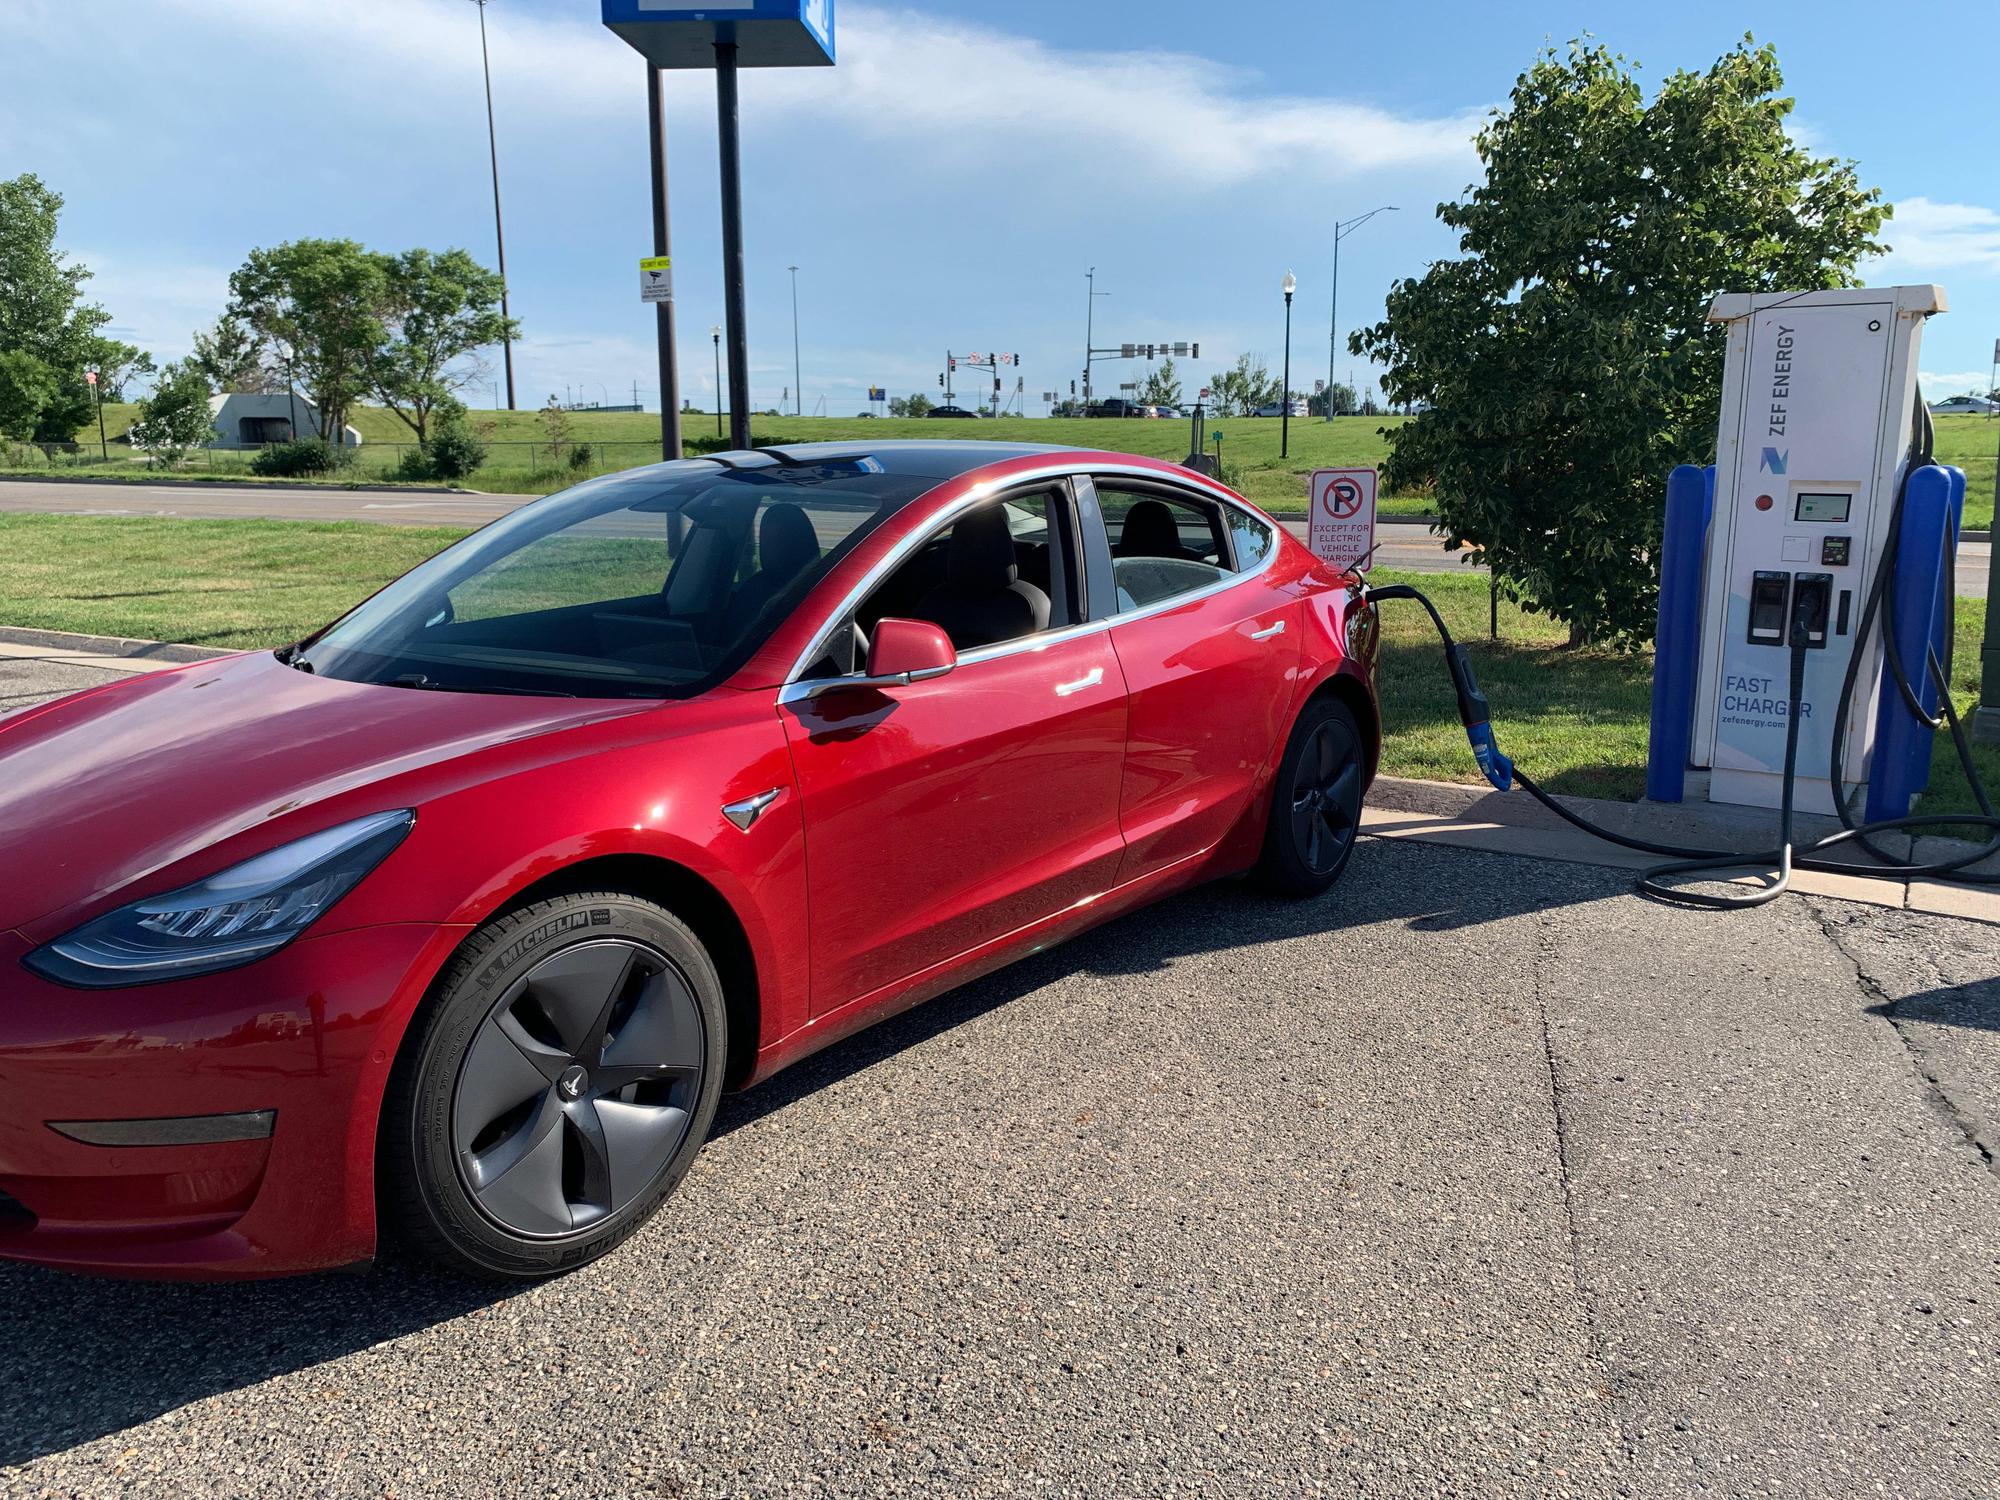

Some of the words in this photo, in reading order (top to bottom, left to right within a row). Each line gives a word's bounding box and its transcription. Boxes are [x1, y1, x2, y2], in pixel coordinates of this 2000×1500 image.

[1772, 326, 1795, 399] ENERGY
[1768, 403, 1786, 437] ZEF
[1313, 524, 1348, 532] EXCEPT
[1351, 524, 1370, 532] FOR
[1319, 534, 1362, 542] ELECTRIC
[1321, 544, 1359, 552] VEHICLE
[1726, 676, 1772, 694] FAST
[1724, 696, 1812, 718] CHARGR
[1721, 715, 1786, 729] zefenergy.com
[500, 911, 586, 968] MICHELIN
